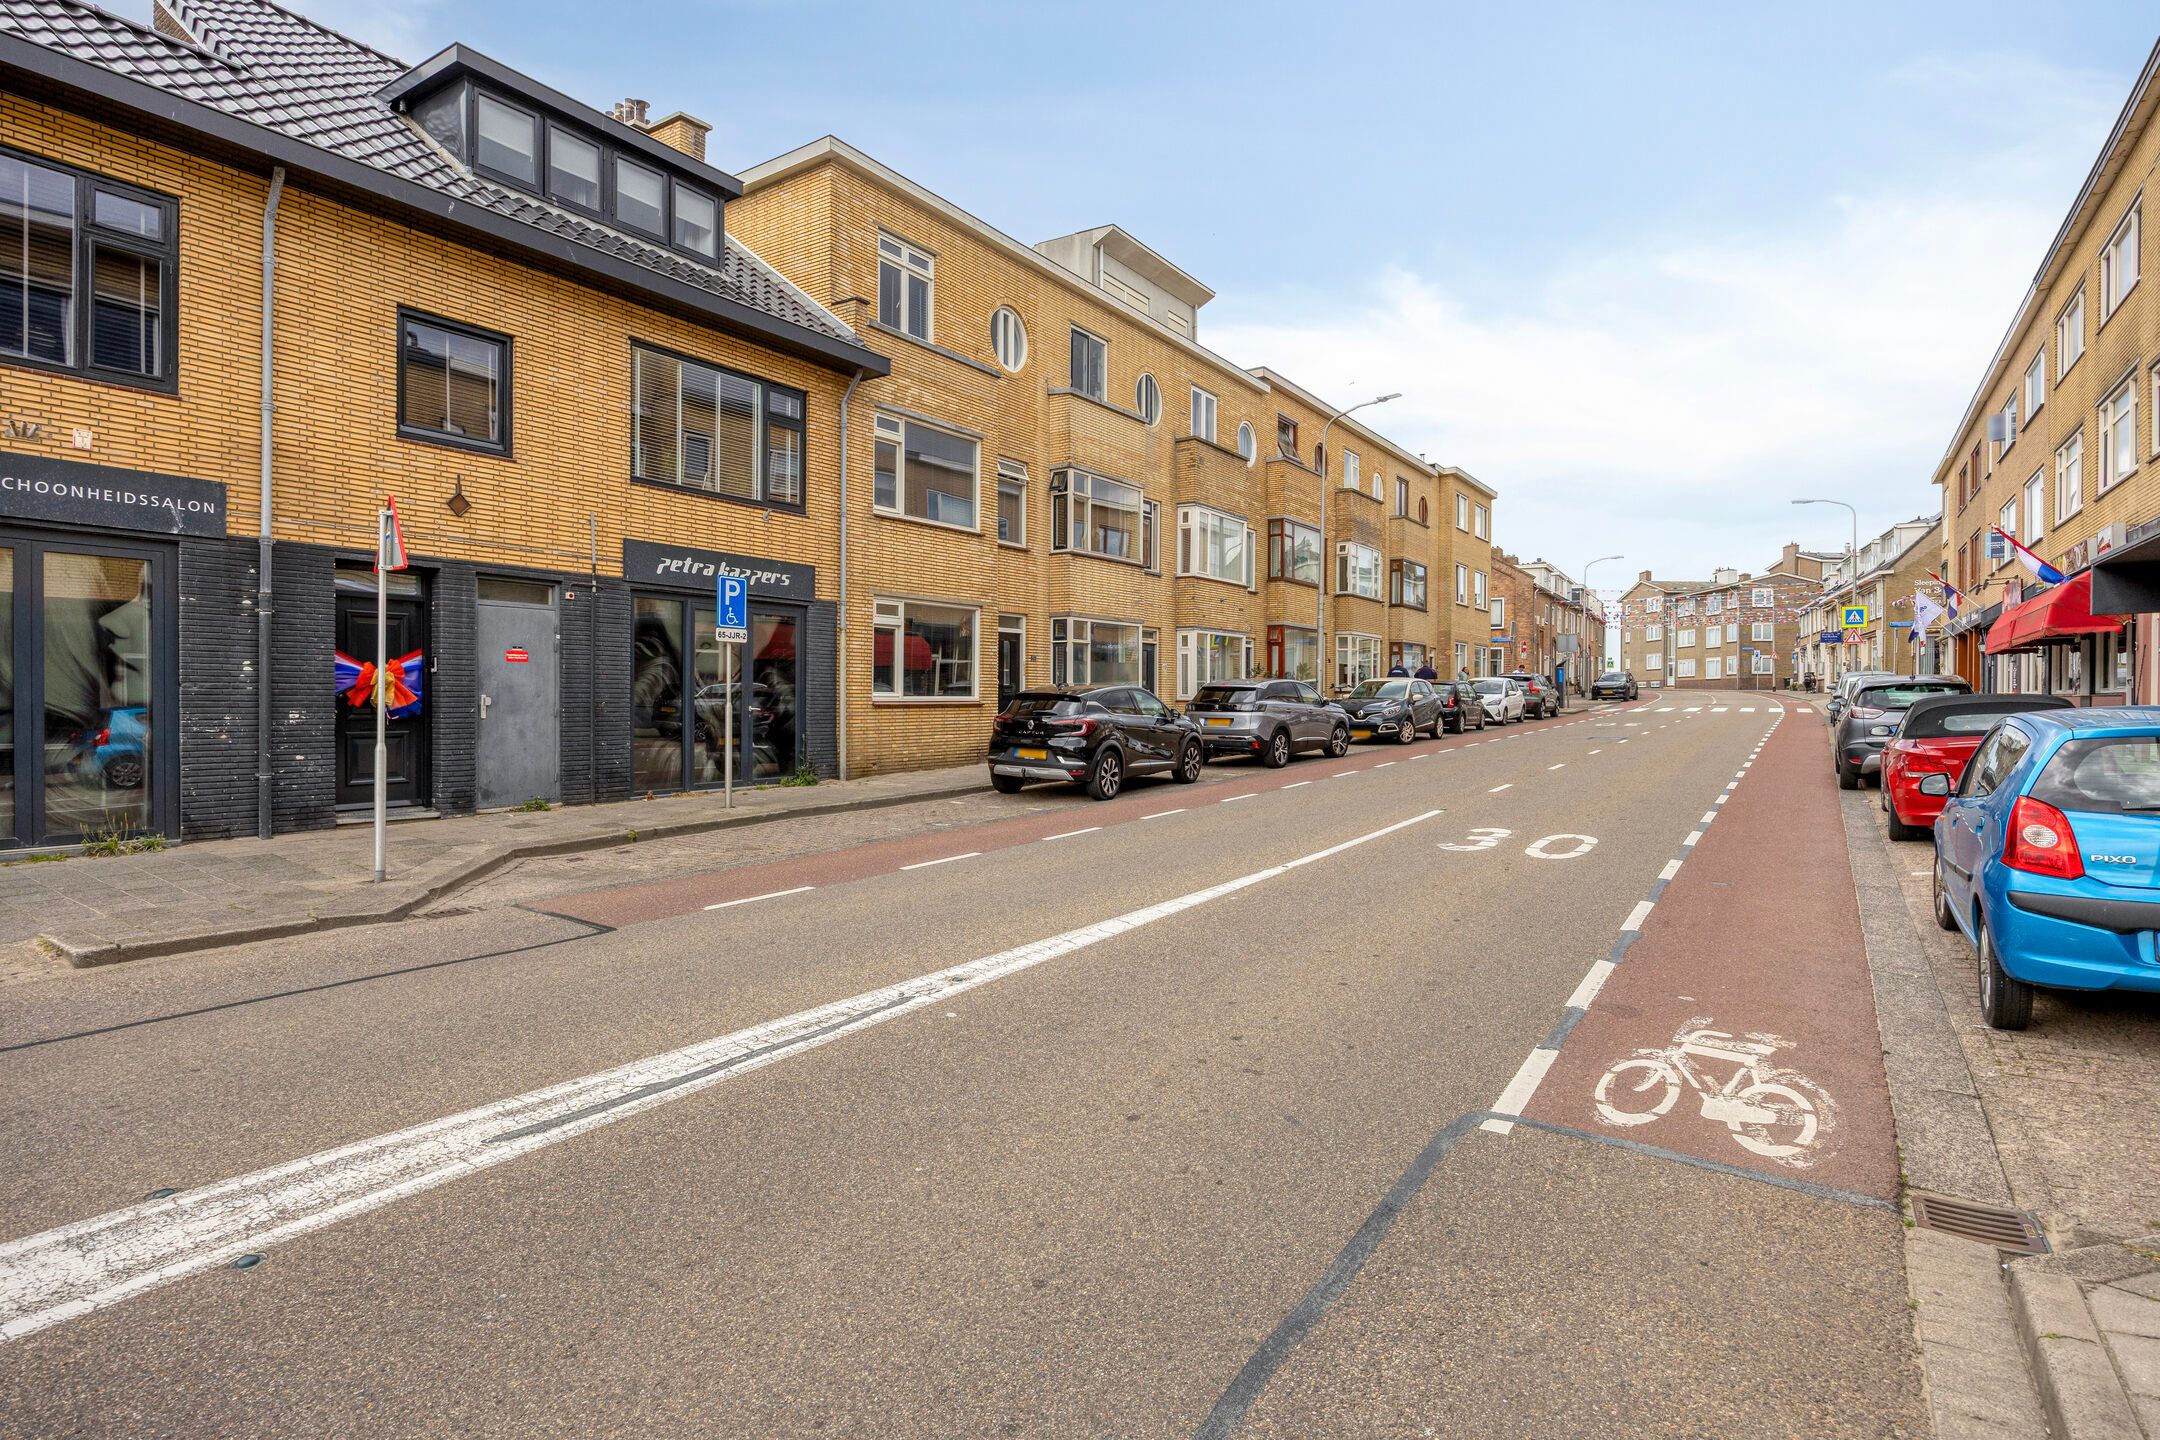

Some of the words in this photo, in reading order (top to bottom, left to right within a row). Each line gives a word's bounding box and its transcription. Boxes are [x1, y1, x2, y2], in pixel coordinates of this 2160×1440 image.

[1, 477, 215, 514] CHOONHEIDSSALON
[725, 579, 741, 606] P
[717, 630, 747, 640] 65-JJR-2
[1437, 827, 1599, 860] 30
[2090, 854, 2138, 865] PIXO
